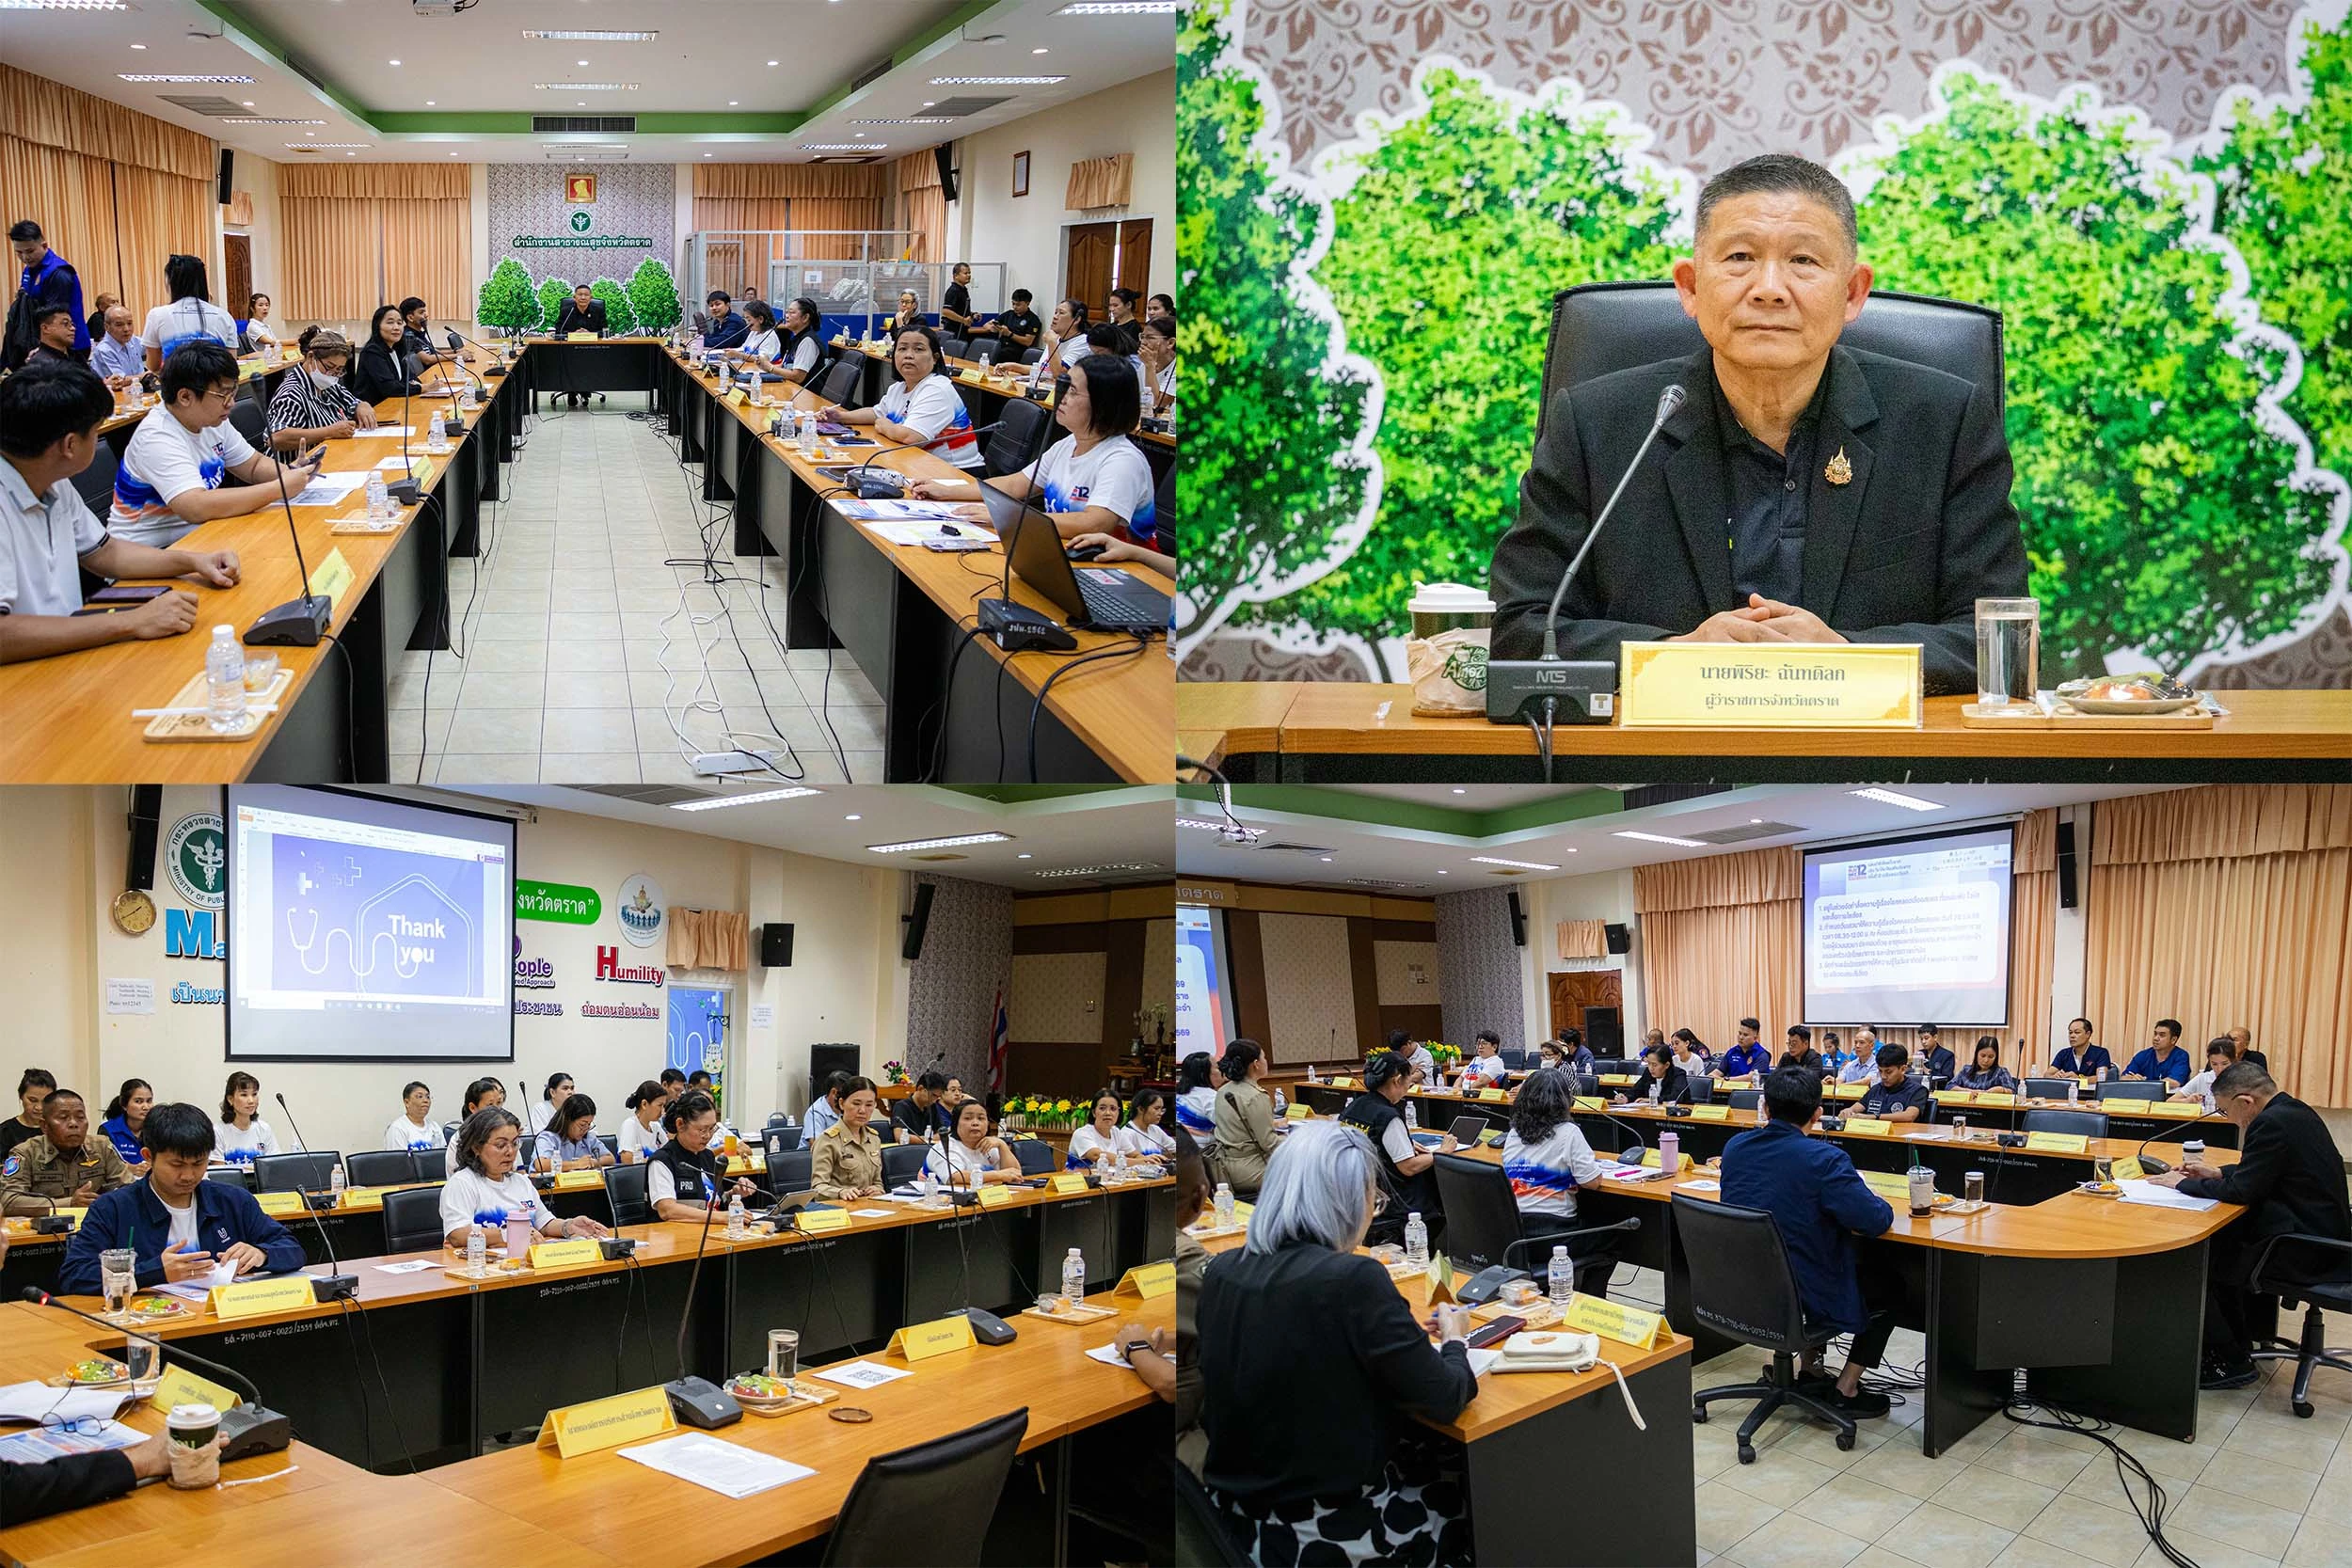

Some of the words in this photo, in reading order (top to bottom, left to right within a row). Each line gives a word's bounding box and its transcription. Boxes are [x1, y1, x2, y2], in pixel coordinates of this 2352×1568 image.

[513, 237, 652, 249] สำนักงานสาธารณสุขจังหวัดตราด
[1700, 664, 1769, 680] นายพิริยะ
[1778, 663, 1845, 681] ฉันทดิลก
[1706, 693, 1839, 709] ผู้ว่าราชการจังหวัดตราด
[172, 865, 195, 895] MINISTRY
[516, 886, 594, 915] งหวัดตราด”
[389, 914, 446, 939] Thank
[400, 946, 435, 966] you
[596, 945, 663, 985] Humility
[581, 1001, 660, 1018] ถ่อมตนอ่อนน้อม
